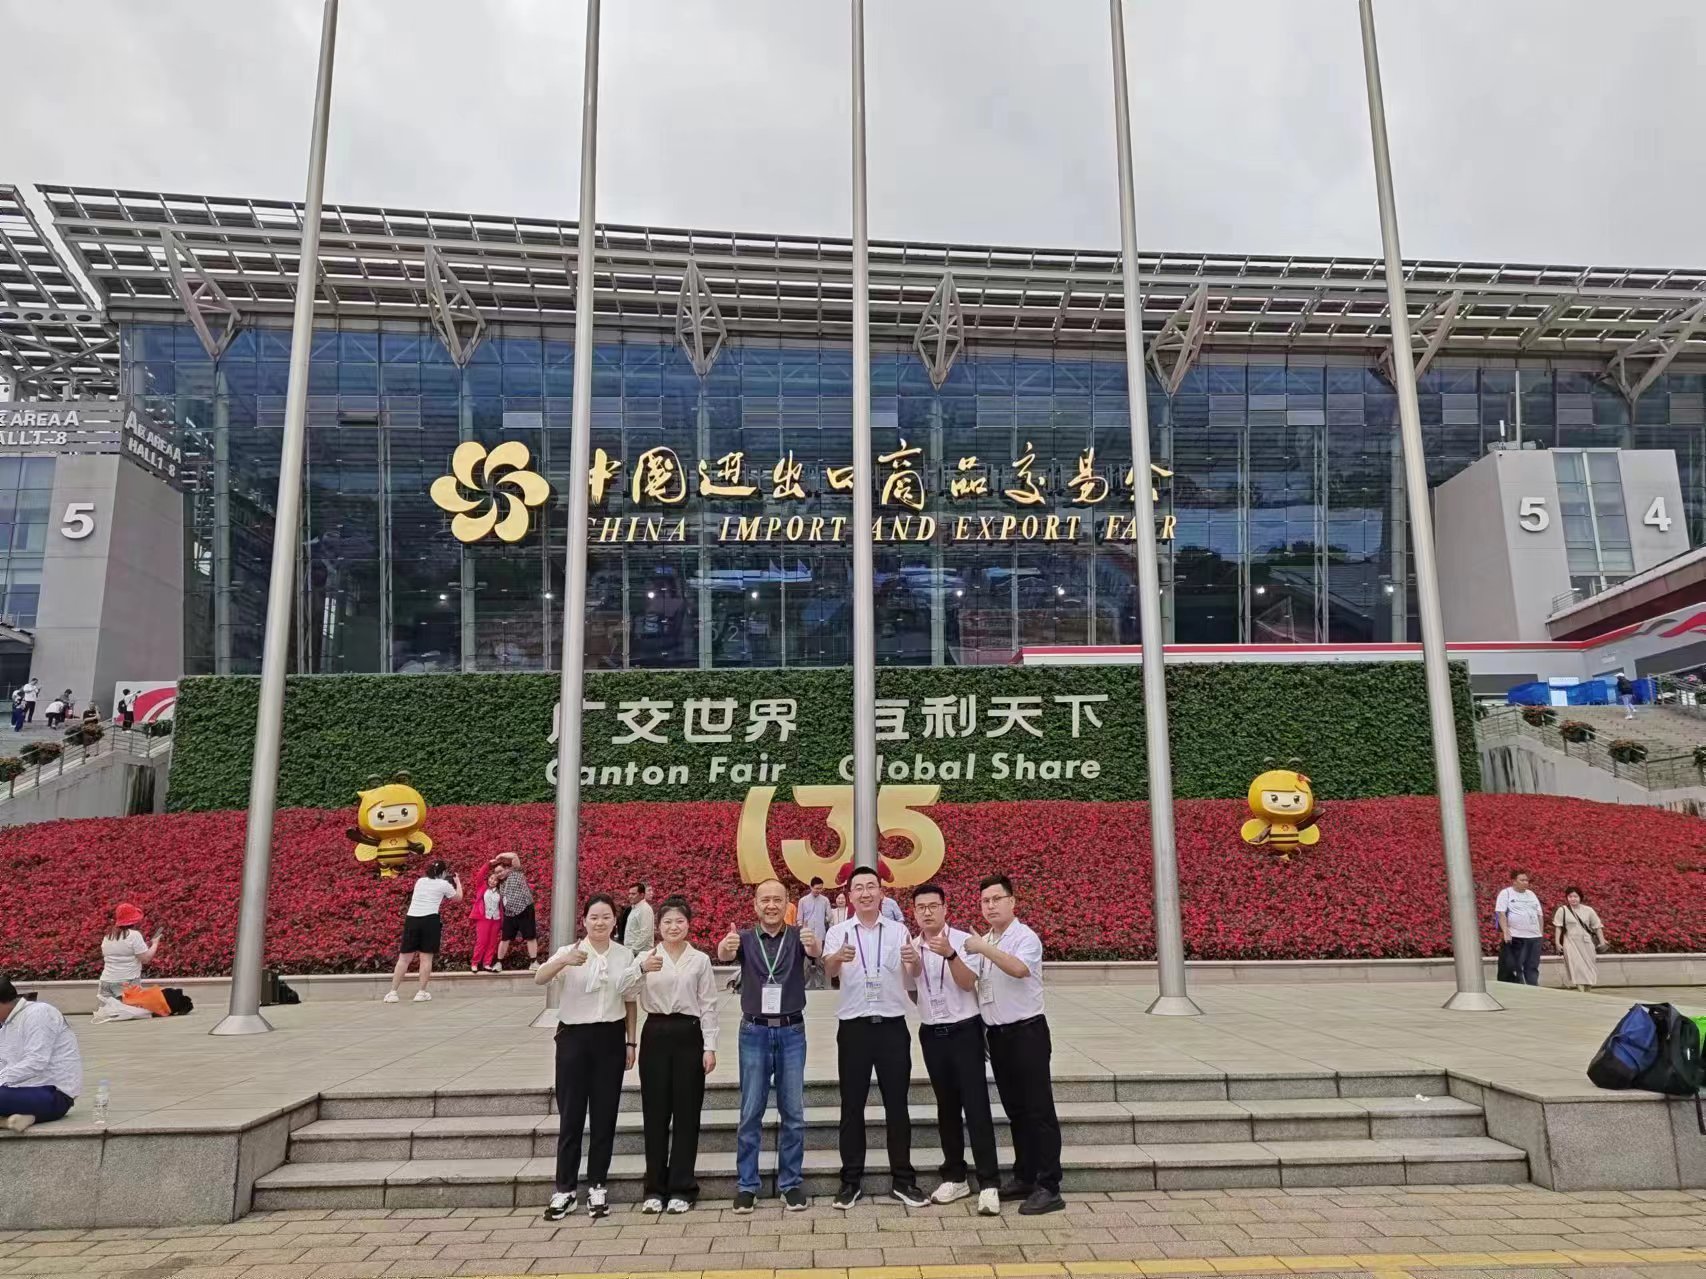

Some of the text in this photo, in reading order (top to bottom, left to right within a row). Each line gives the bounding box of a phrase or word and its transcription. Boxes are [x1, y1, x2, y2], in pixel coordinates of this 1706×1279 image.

[10, 413, 60, 426] AREA
[63, 410, 79, 426] A
[147, 431, 173, 458] AREA
[61, 502, 96, 539] 5
[718, 515, 848, 541] IMPORT
[872, 515, 937, 541] AND
[955, 514, 1081, 540] EXPORT
[1104, 515, 1177, 540] FAR
[1519, 497, 1550, 532] 5
[1643, 496, 1672, 532] 4
[708, 753, 787, 783] Fair
[991, 752, 1101, 780] Share
[737, 785, 945, 889] 135
